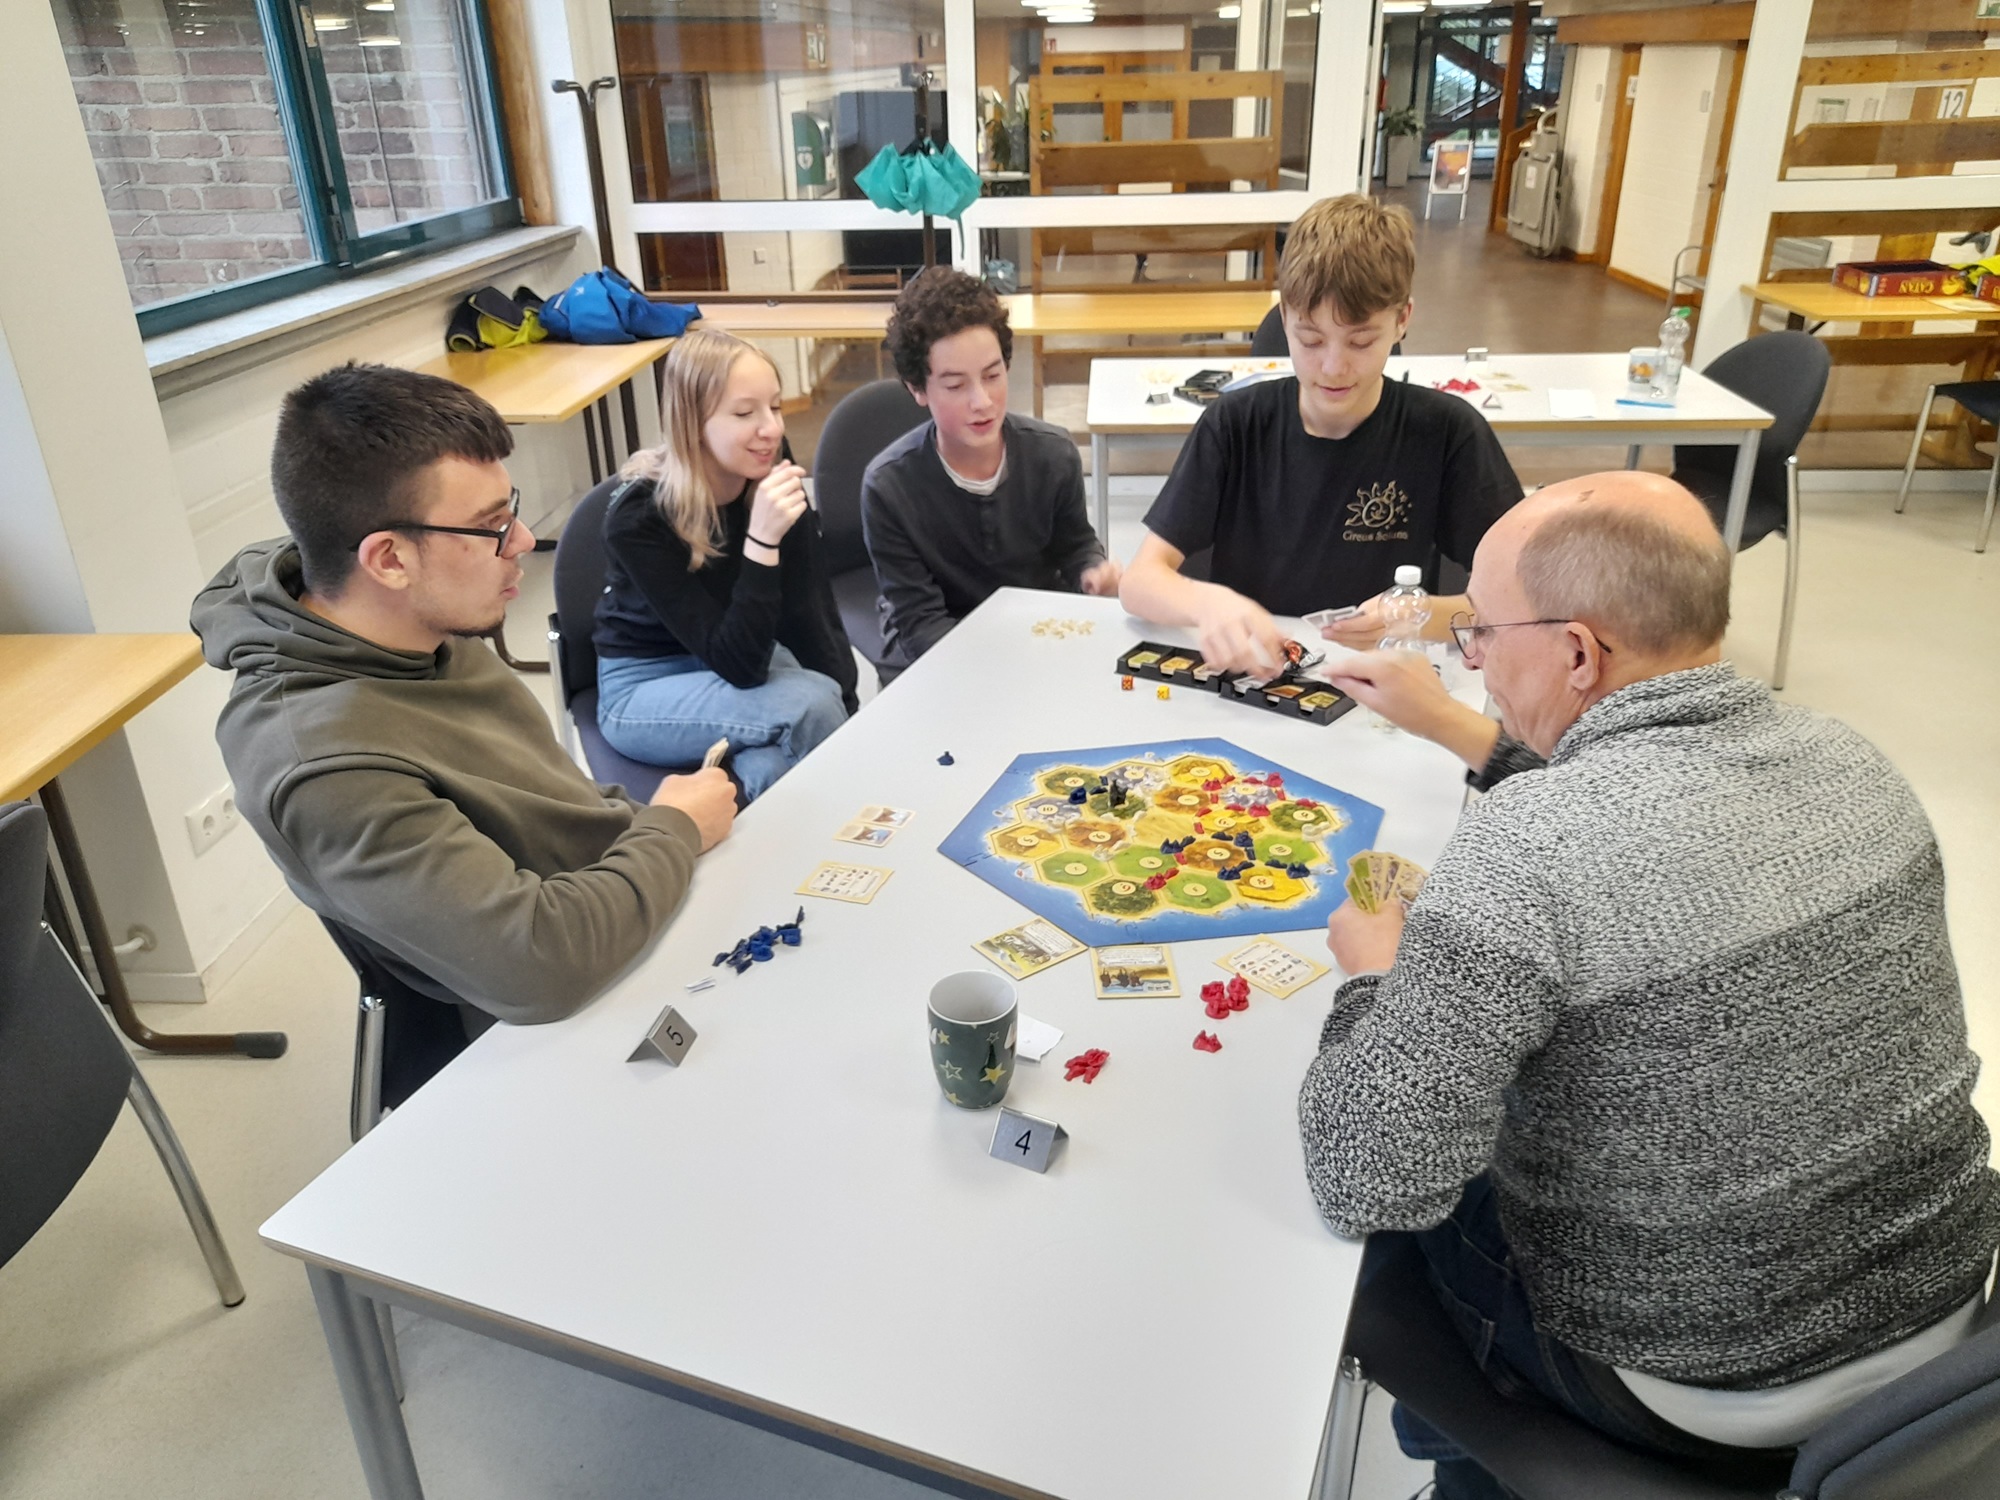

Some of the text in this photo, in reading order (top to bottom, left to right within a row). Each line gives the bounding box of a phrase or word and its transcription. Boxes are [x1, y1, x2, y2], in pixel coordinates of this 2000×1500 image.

[1943, 91, 1964, 119] 12
[1899, 278, 1935, 294] CATAN
[1342, 530, 1374, 541] Circus
[665, 1025, 684, 1047] 5
[1014, 1129, 1032, 1156] 4
